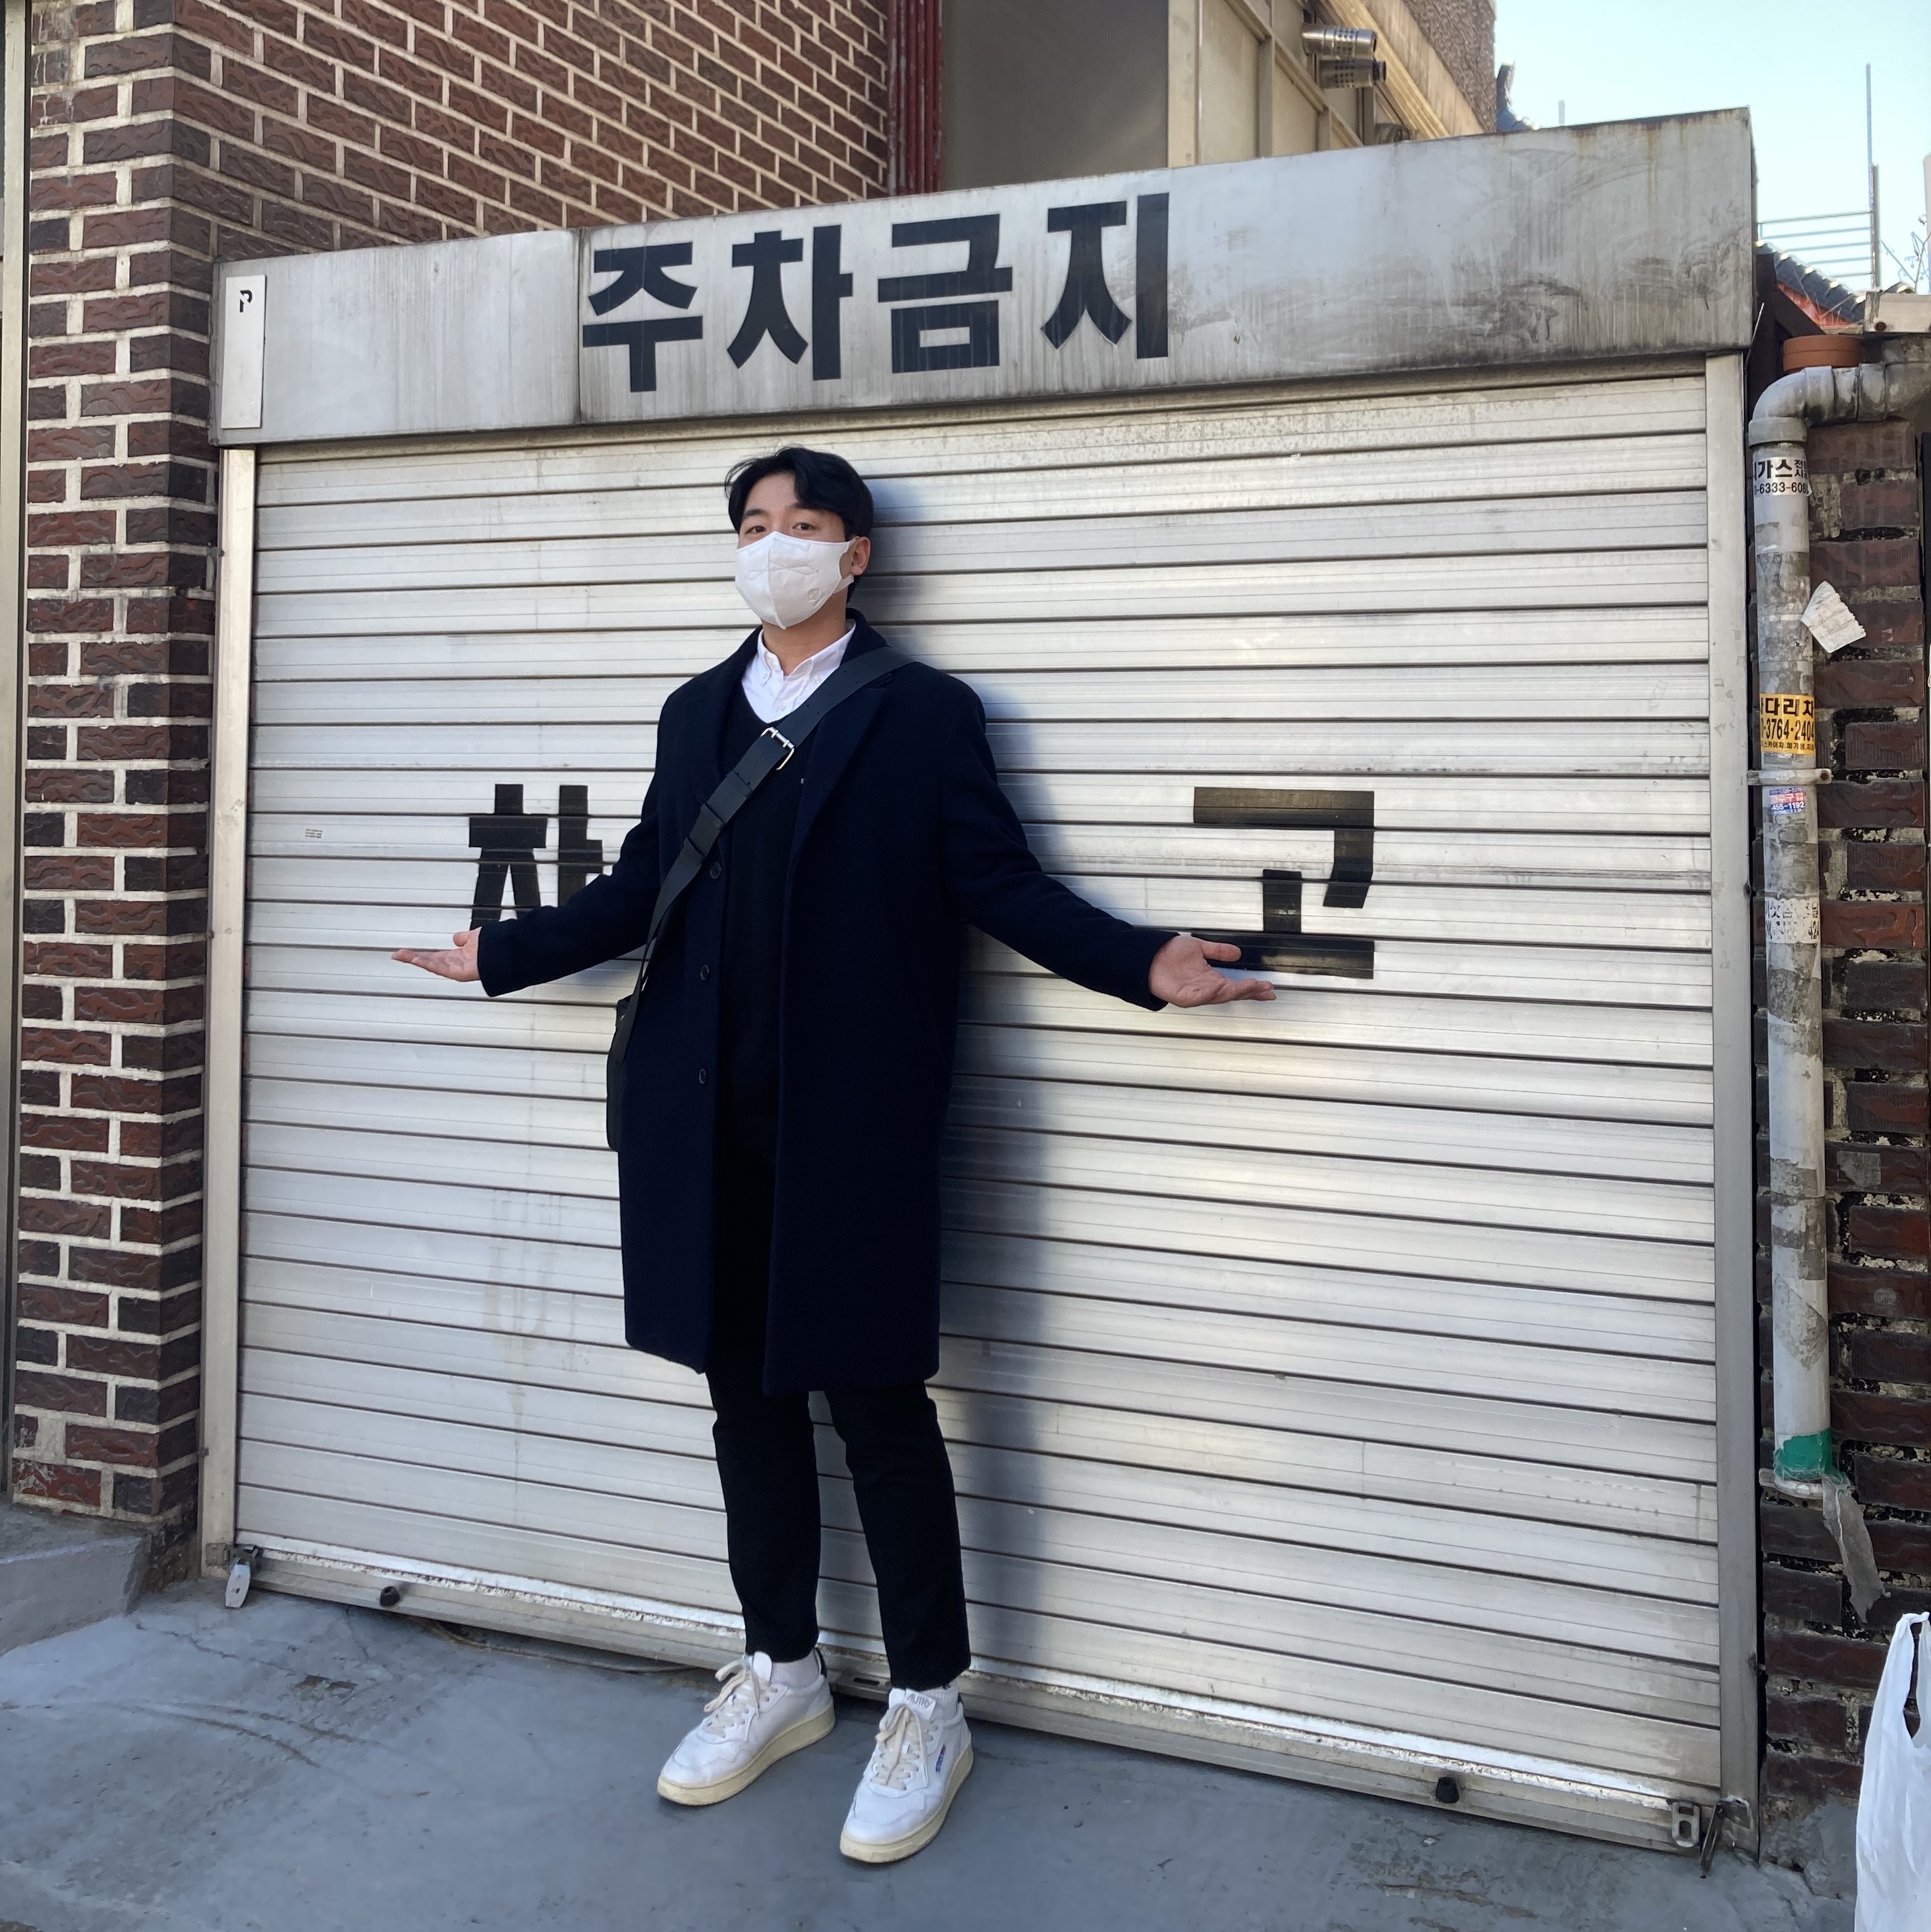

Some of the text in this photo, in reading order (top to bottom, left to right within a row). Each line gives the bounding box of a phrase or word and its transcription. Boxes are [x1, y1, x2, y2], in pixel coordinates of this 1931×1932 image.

[582, 192, 1170, 392] 주차금지
[1761, 697, 1814, 718] 다리차
[469, 784, 1375, 980] 차 고
